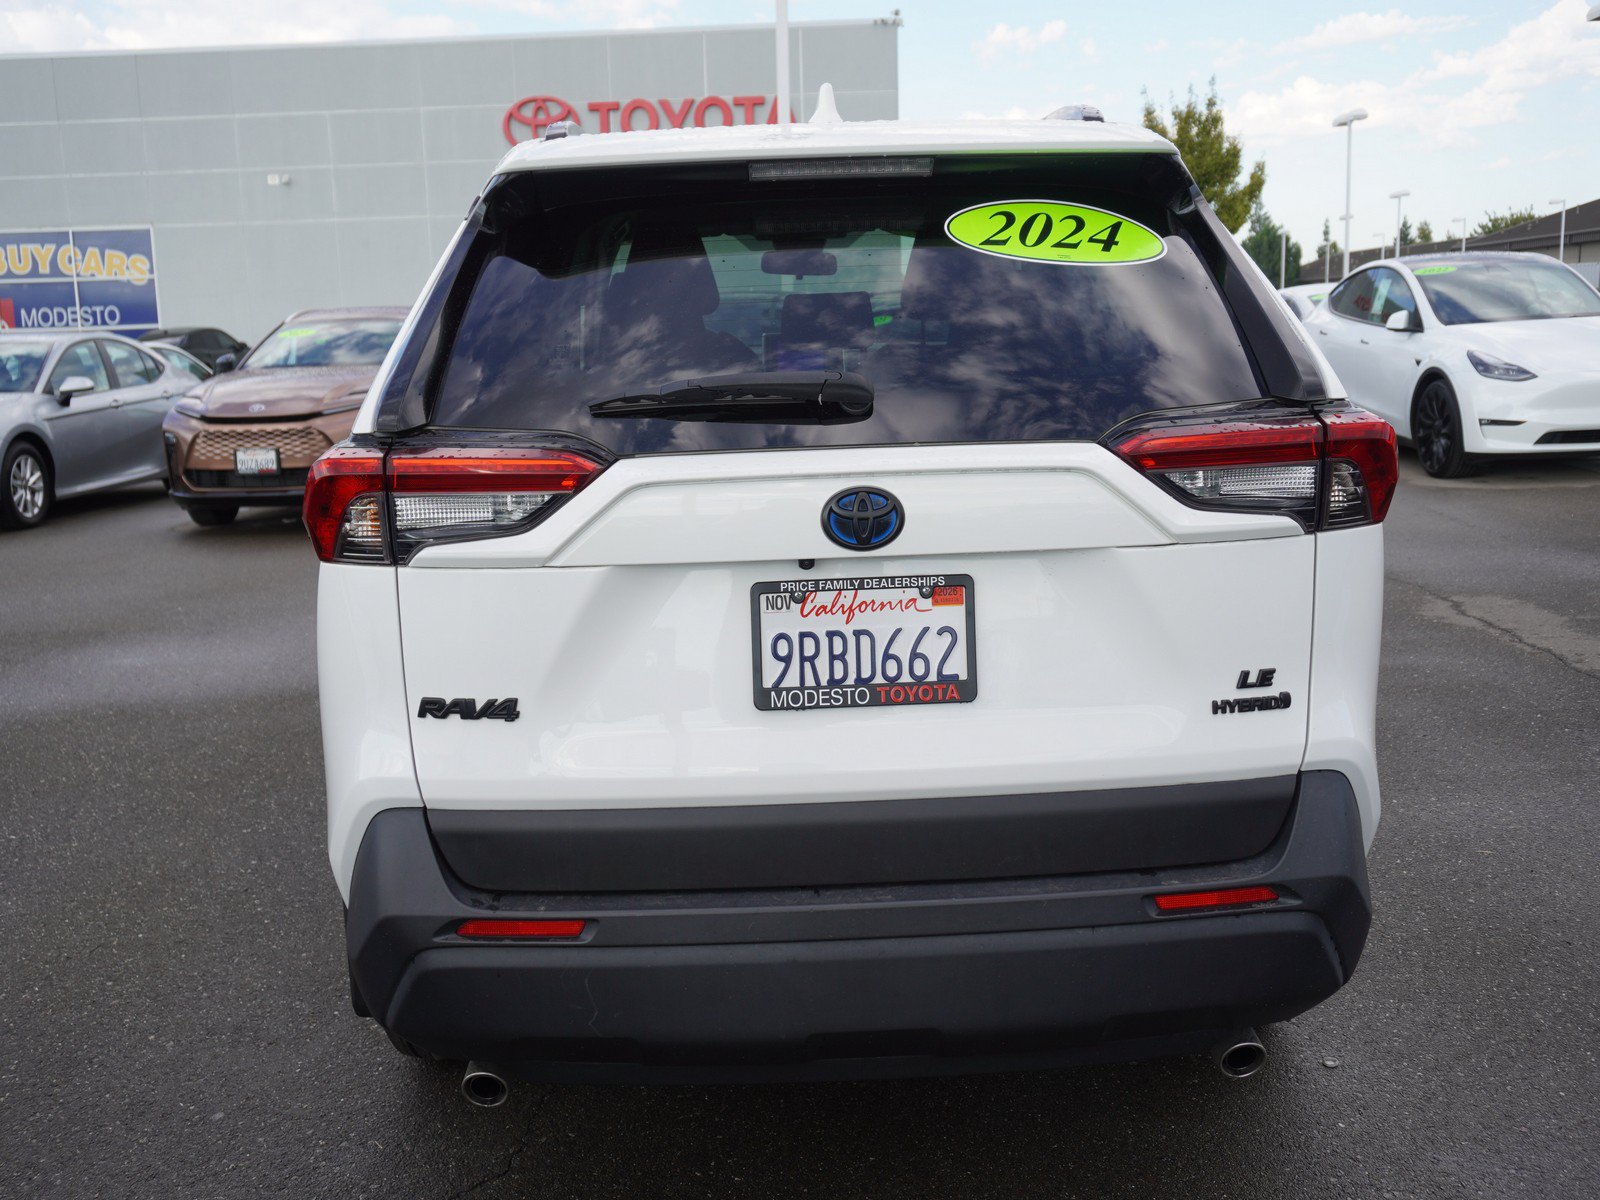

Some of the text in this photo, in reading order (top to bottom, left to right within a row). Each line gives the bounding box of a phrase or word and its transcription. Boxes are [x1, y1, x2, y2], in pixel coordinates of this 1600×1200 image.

[979, 210, 1123, 253] 2024
[57, 244, 150, 286] CARS
[21, 305, 120, 328] MODESTO
[780, 576, 945, 592] PRICE FAMILY DEALERSHIPS
[765, 594, 793, 611] NOV
[799, 590, 933, 625] California
[770, 625, 960, 689] 9RBD662
[1236, 668, 1276, 689] LE
[771, 684, 961, 708] MODESTO TOYOTA
[1212, 695, 1281, 715] HYBRID
[417, 697, 520, 722] RAV4
